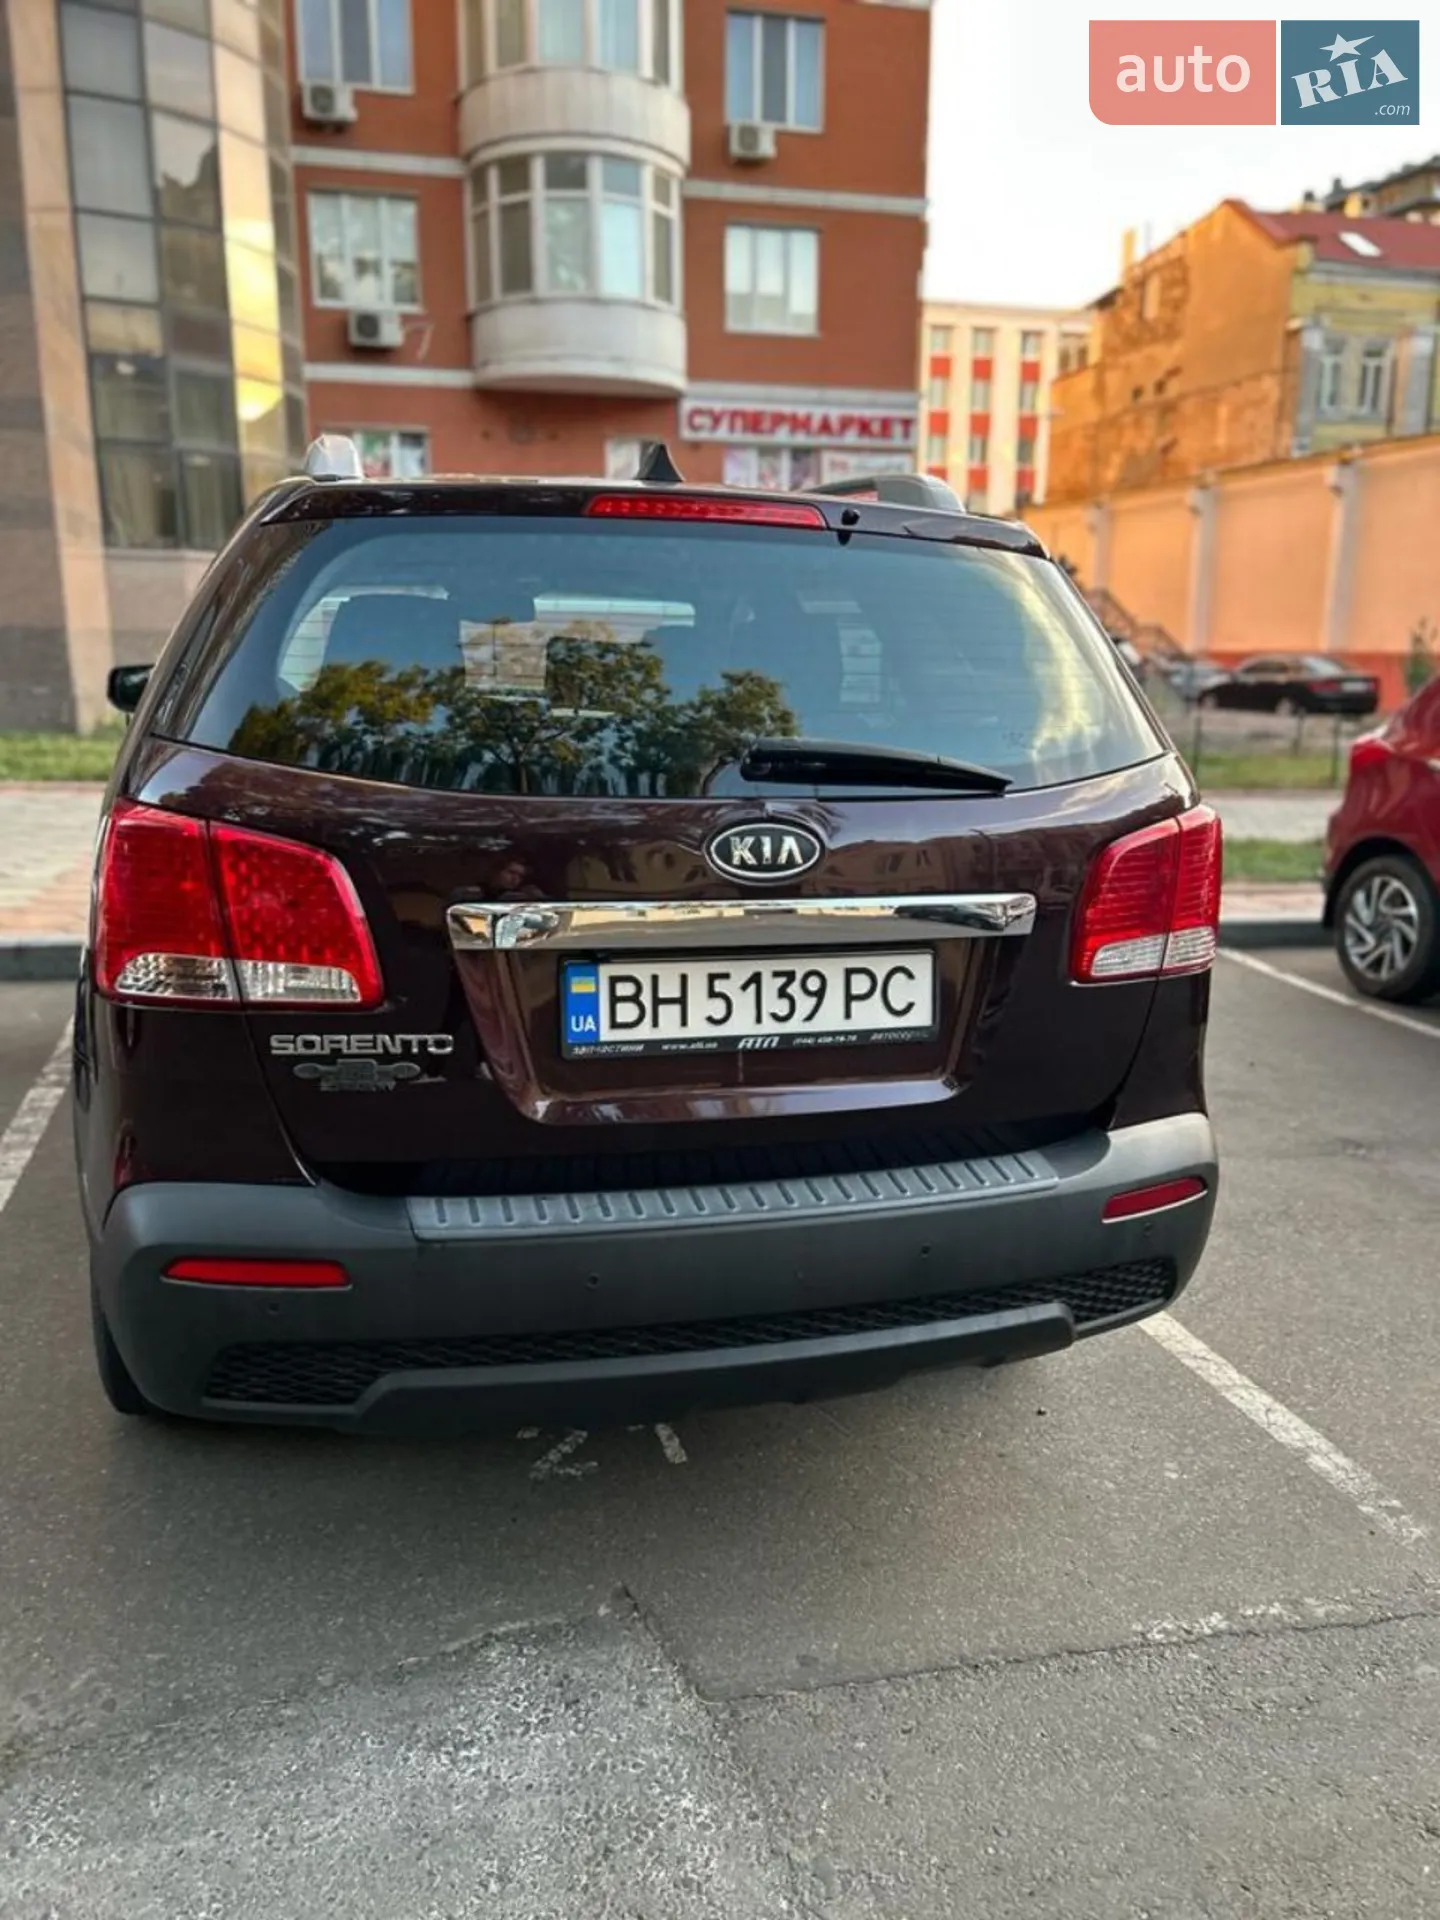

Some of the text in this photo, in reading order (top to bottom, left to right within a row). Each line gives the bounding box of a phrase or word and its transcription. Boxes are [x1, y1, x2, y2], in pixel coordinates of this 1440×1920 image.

[686, 406, 916, 440] СУПЕРМАРКЕТ
[729, 835, 804, 866] KIA
[607, 964, 916, 1031] BH 5139 PC
[570, 1015, 597, 1033] UA
[269, 1034, 455, 1055] SORENTO
